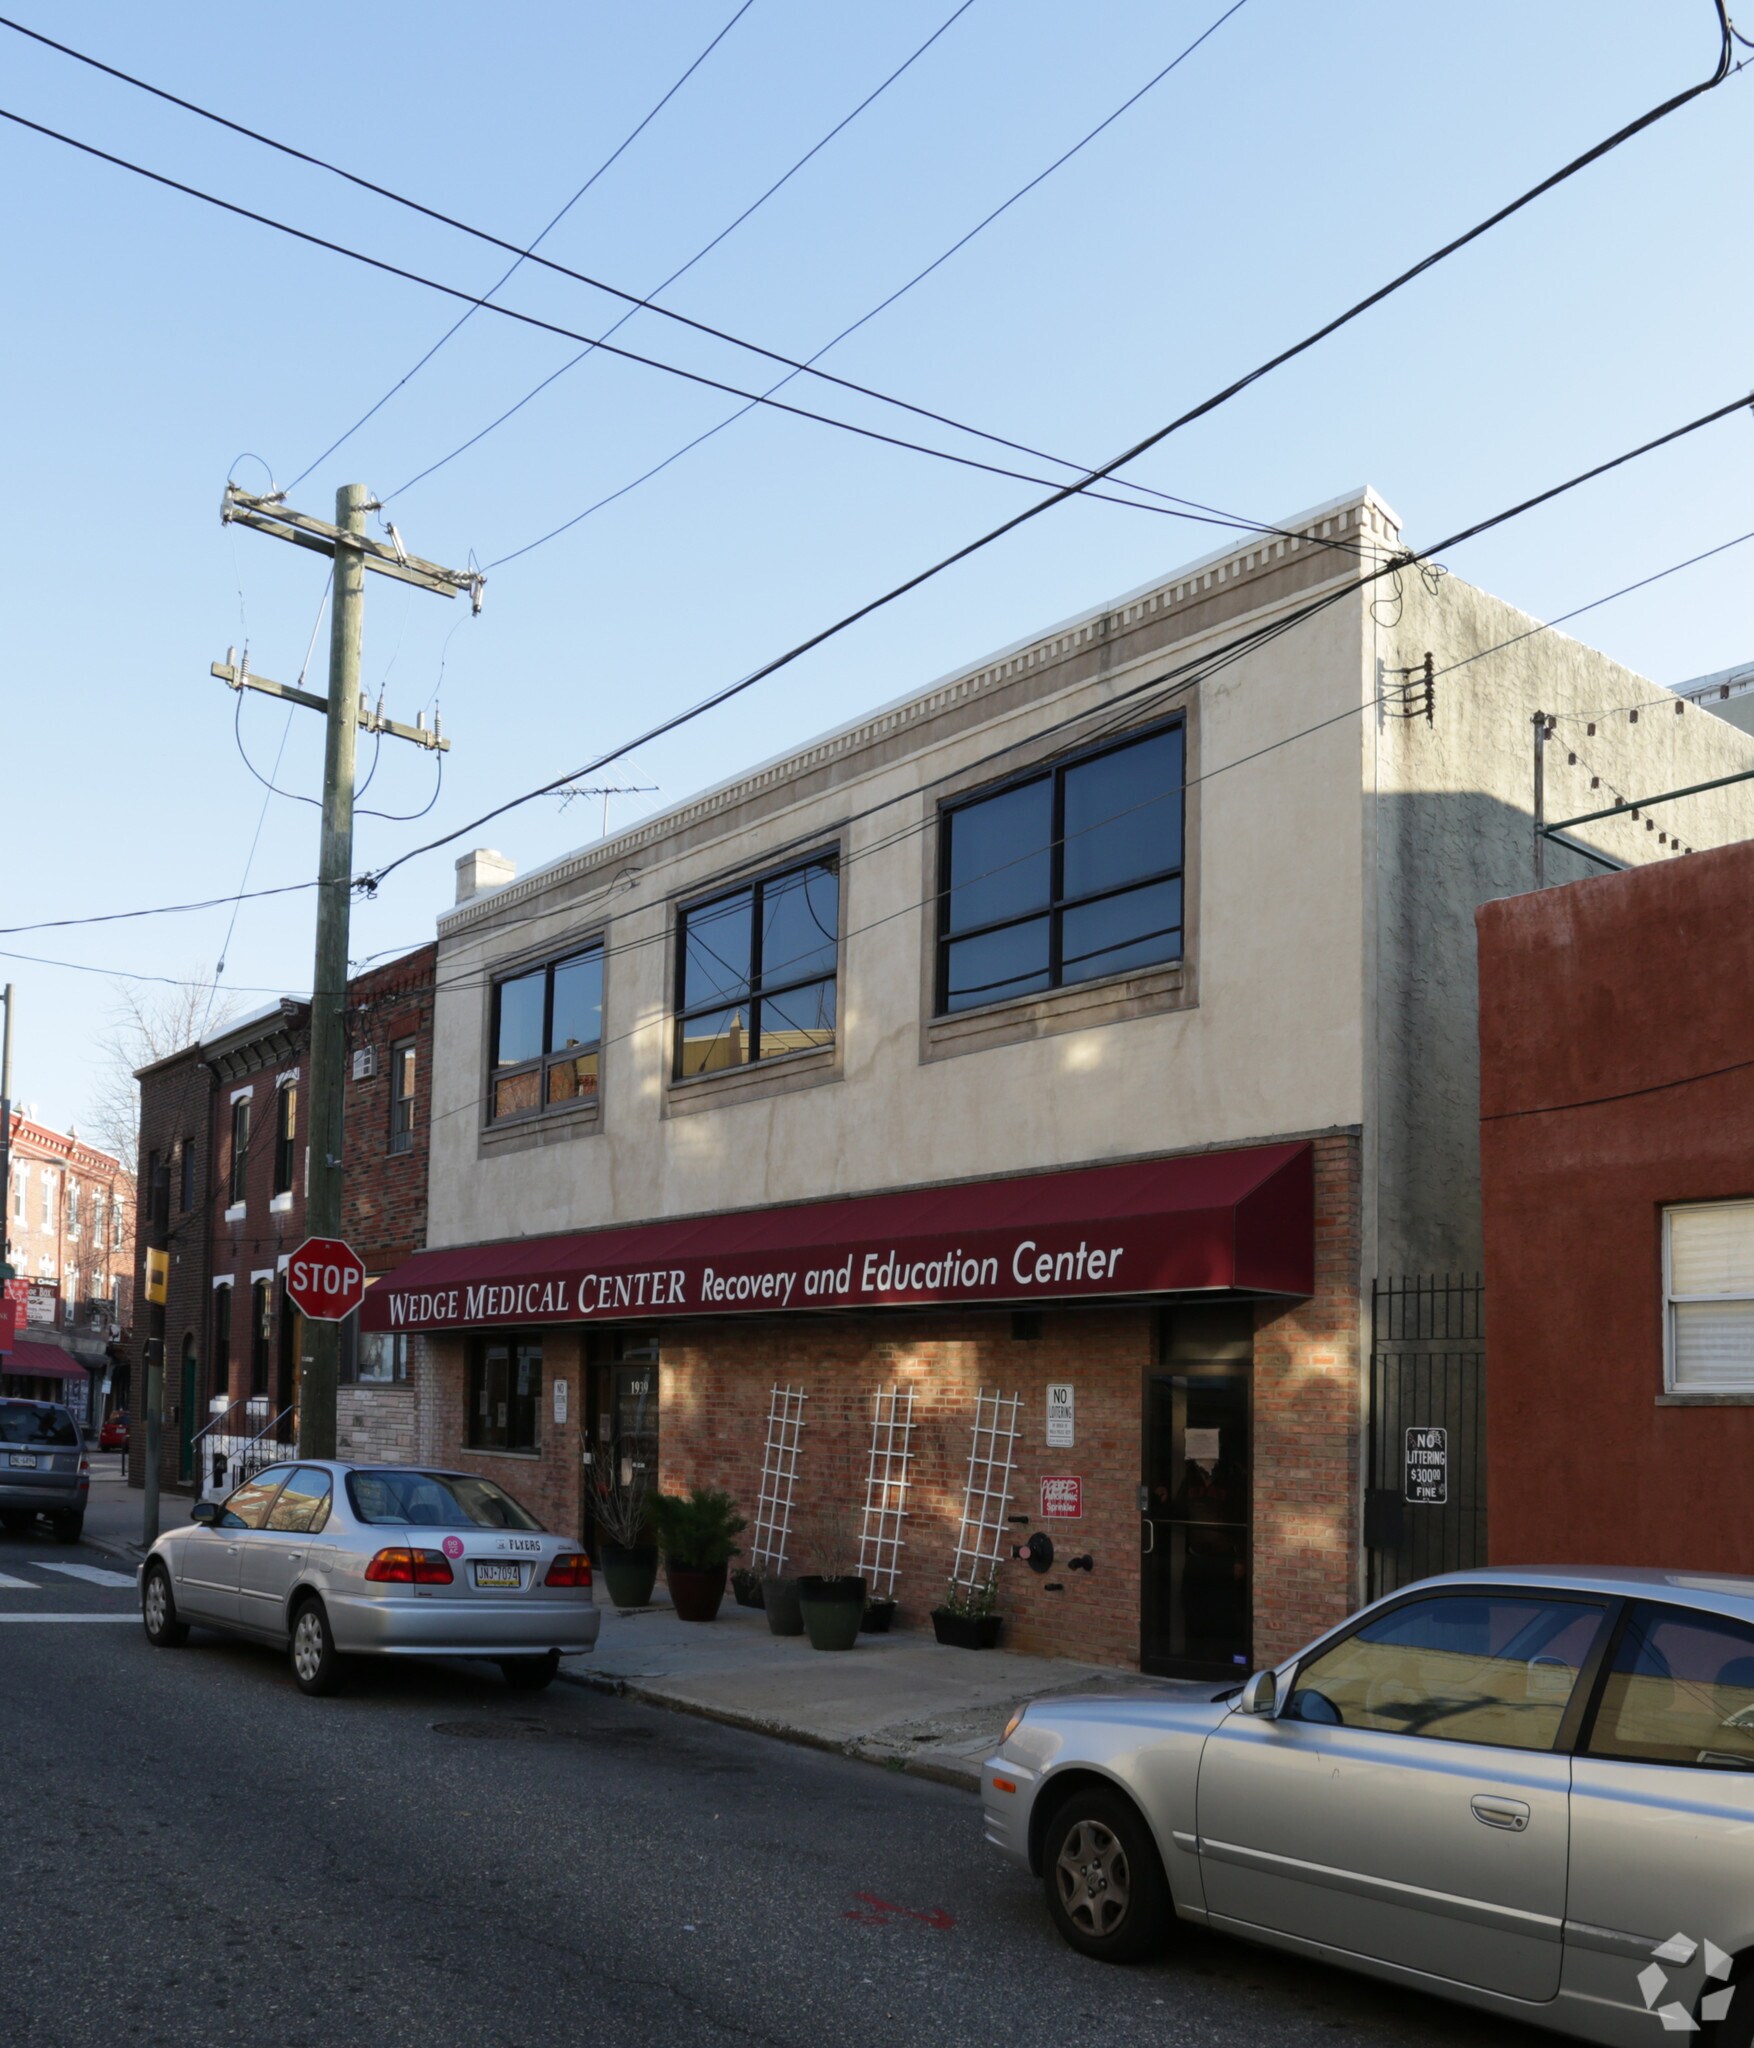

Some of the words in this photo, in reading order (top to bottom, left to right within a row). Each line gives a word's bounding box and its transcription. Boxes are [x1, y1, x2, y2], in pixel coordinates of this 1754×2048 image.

[292, 1261, 360, 1296] STOP
[388, 1291, 458, 1326] WEDGE
[464, 1281, 570, 1321] MEDICAL
[577, 1270, 687, 1314] CENTER
[700, 1267, 797, 1307] Recovery
[804, 1254, 854, 1296] and
[860, 1249, 999, 1292] Education
[1012, 1241, 1124, 1284] Center
[631, 1381, 648, 1395] 1939
[1053, 1388, 1067, 1404] NO
[1417, 1433, 1435, 1448] NO
[1407, 1450, 1445, 1465] LITTERING
[1416, 1487, 1437, 1497] FINE
[1046, 1502, 1076, 1513] Sprinkler
[509, 1539, 541, 1552] FLYERS
